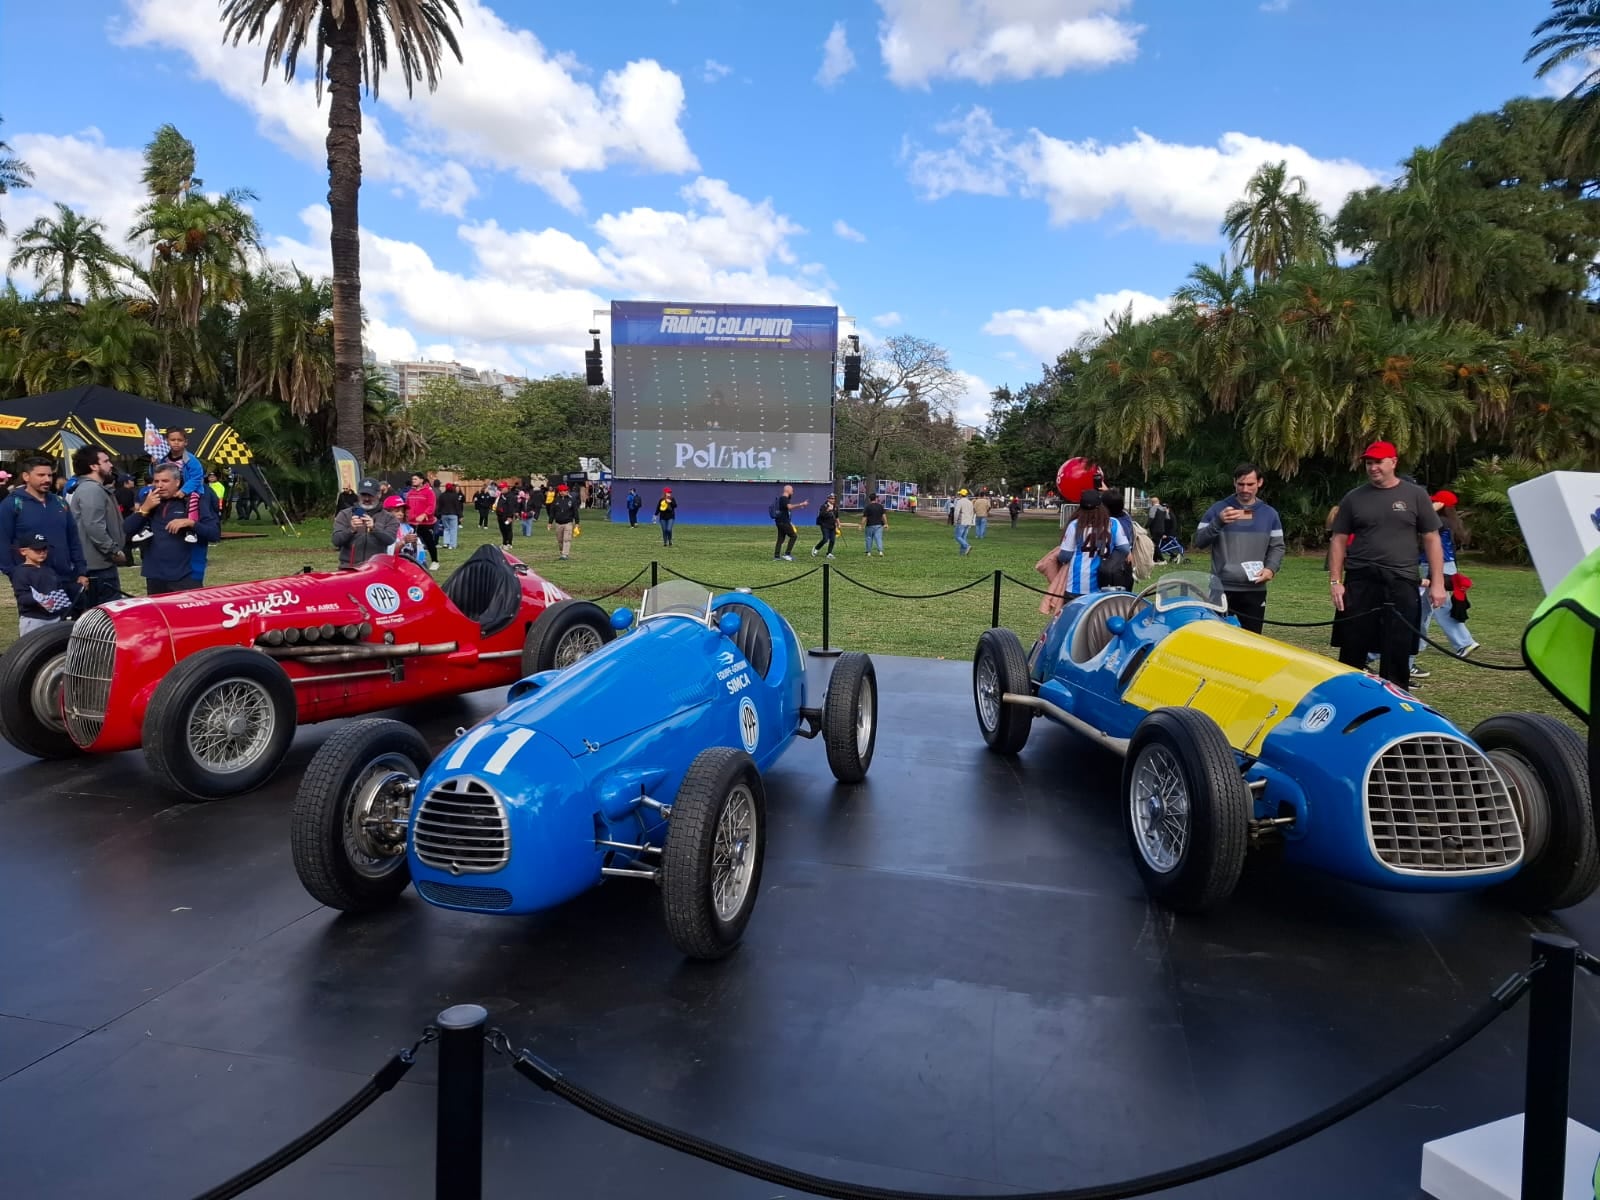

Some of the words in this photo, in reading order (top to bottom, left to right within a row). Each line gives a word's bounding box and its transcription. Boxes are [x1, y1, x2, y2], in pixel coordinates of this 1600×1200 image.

[660, 315, 715, 334] FRANCO
[716, 317, 792, 336] COLAPINTO
[100, 421, 137, 435] PIRELLI
[371, 586, 395, 609] YPF
[726, 672, 751, 695] SIMCA
[743, 705, 756, 745] YPF
[1307, 706, 1331, 728] YPF
